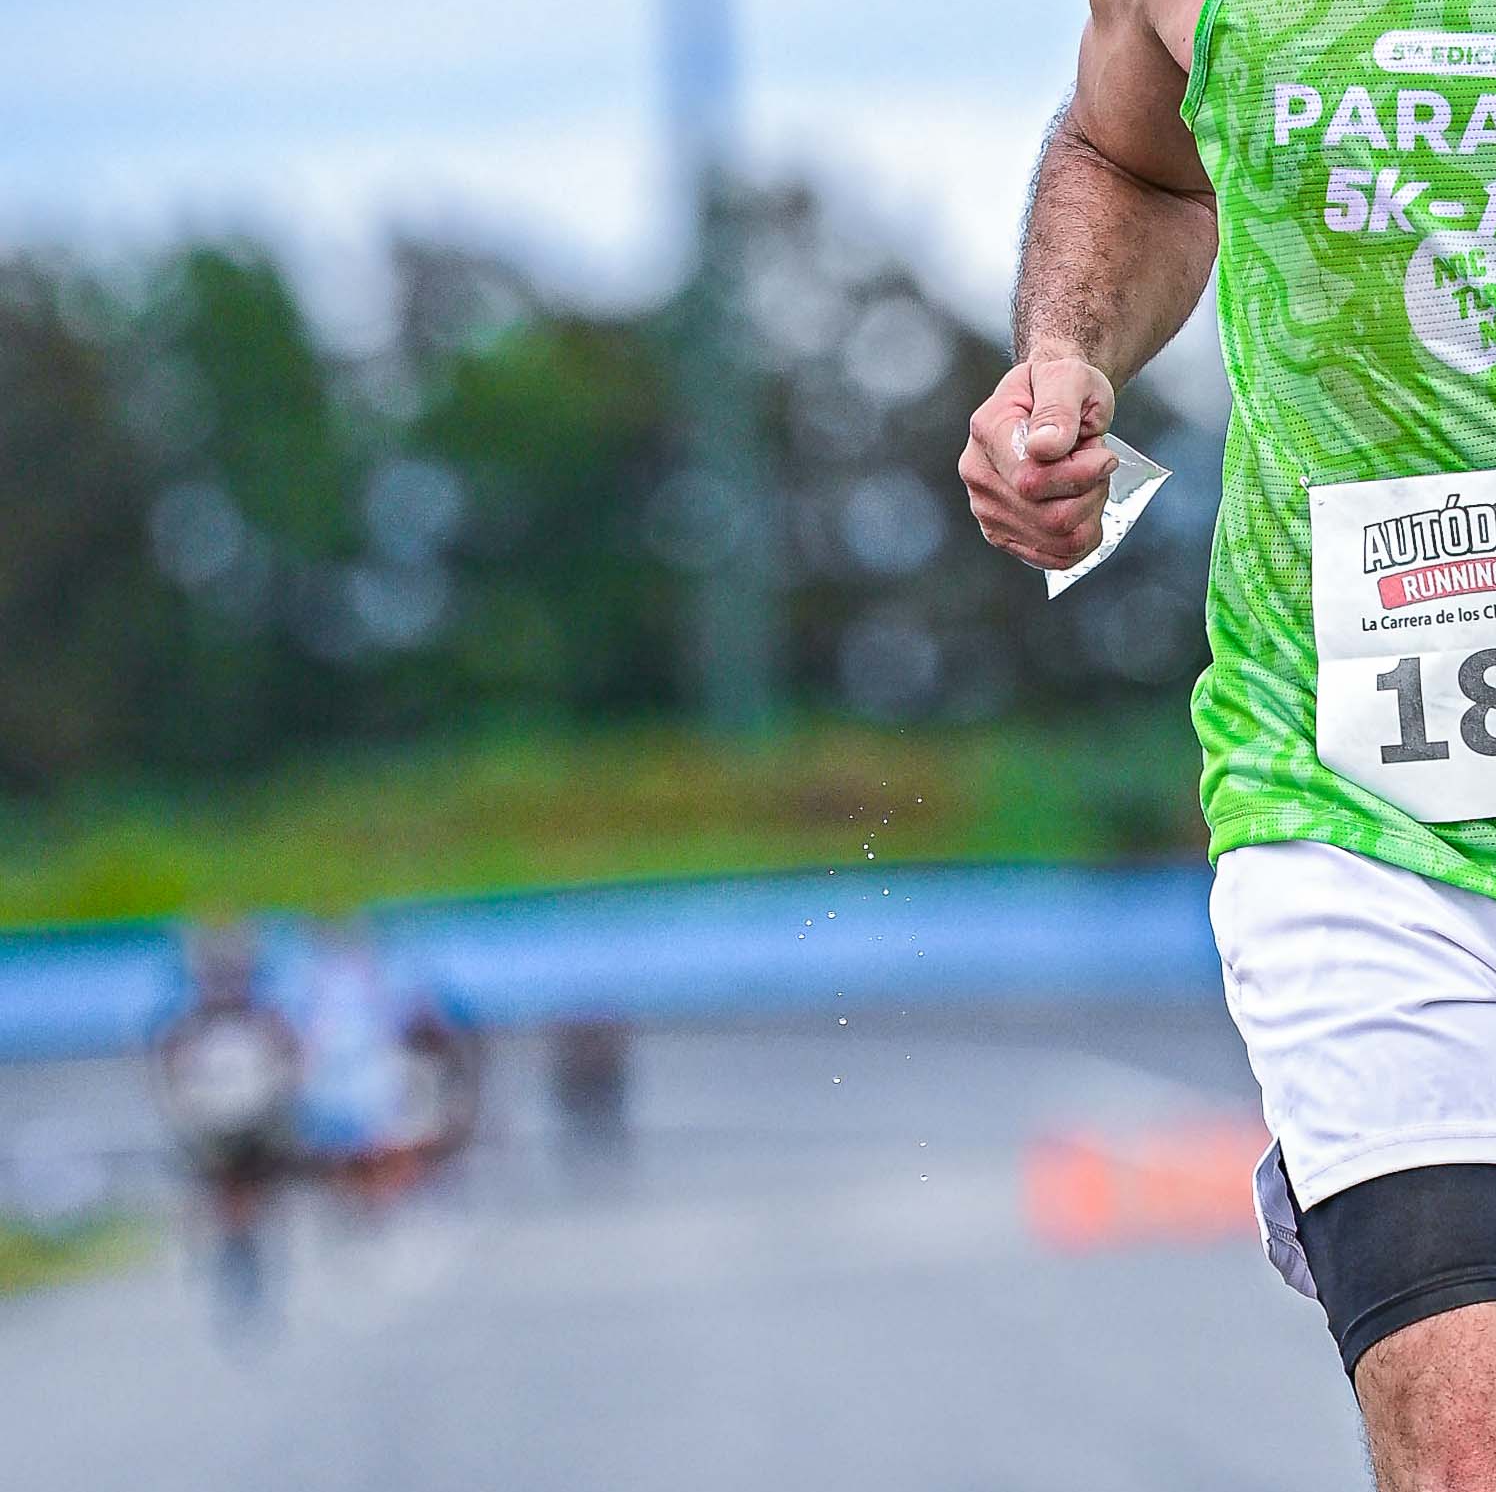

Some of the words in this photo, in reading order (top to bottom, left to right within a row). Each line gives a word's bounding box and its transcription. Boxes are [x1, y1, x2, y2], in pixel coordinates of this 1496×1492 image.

[1362, 617, 1378, 632] La
[1381, 615, 1432, 630] Carrera
[1436, 608, 1455, 625] de
[1458, 606, 1480, 622] los
